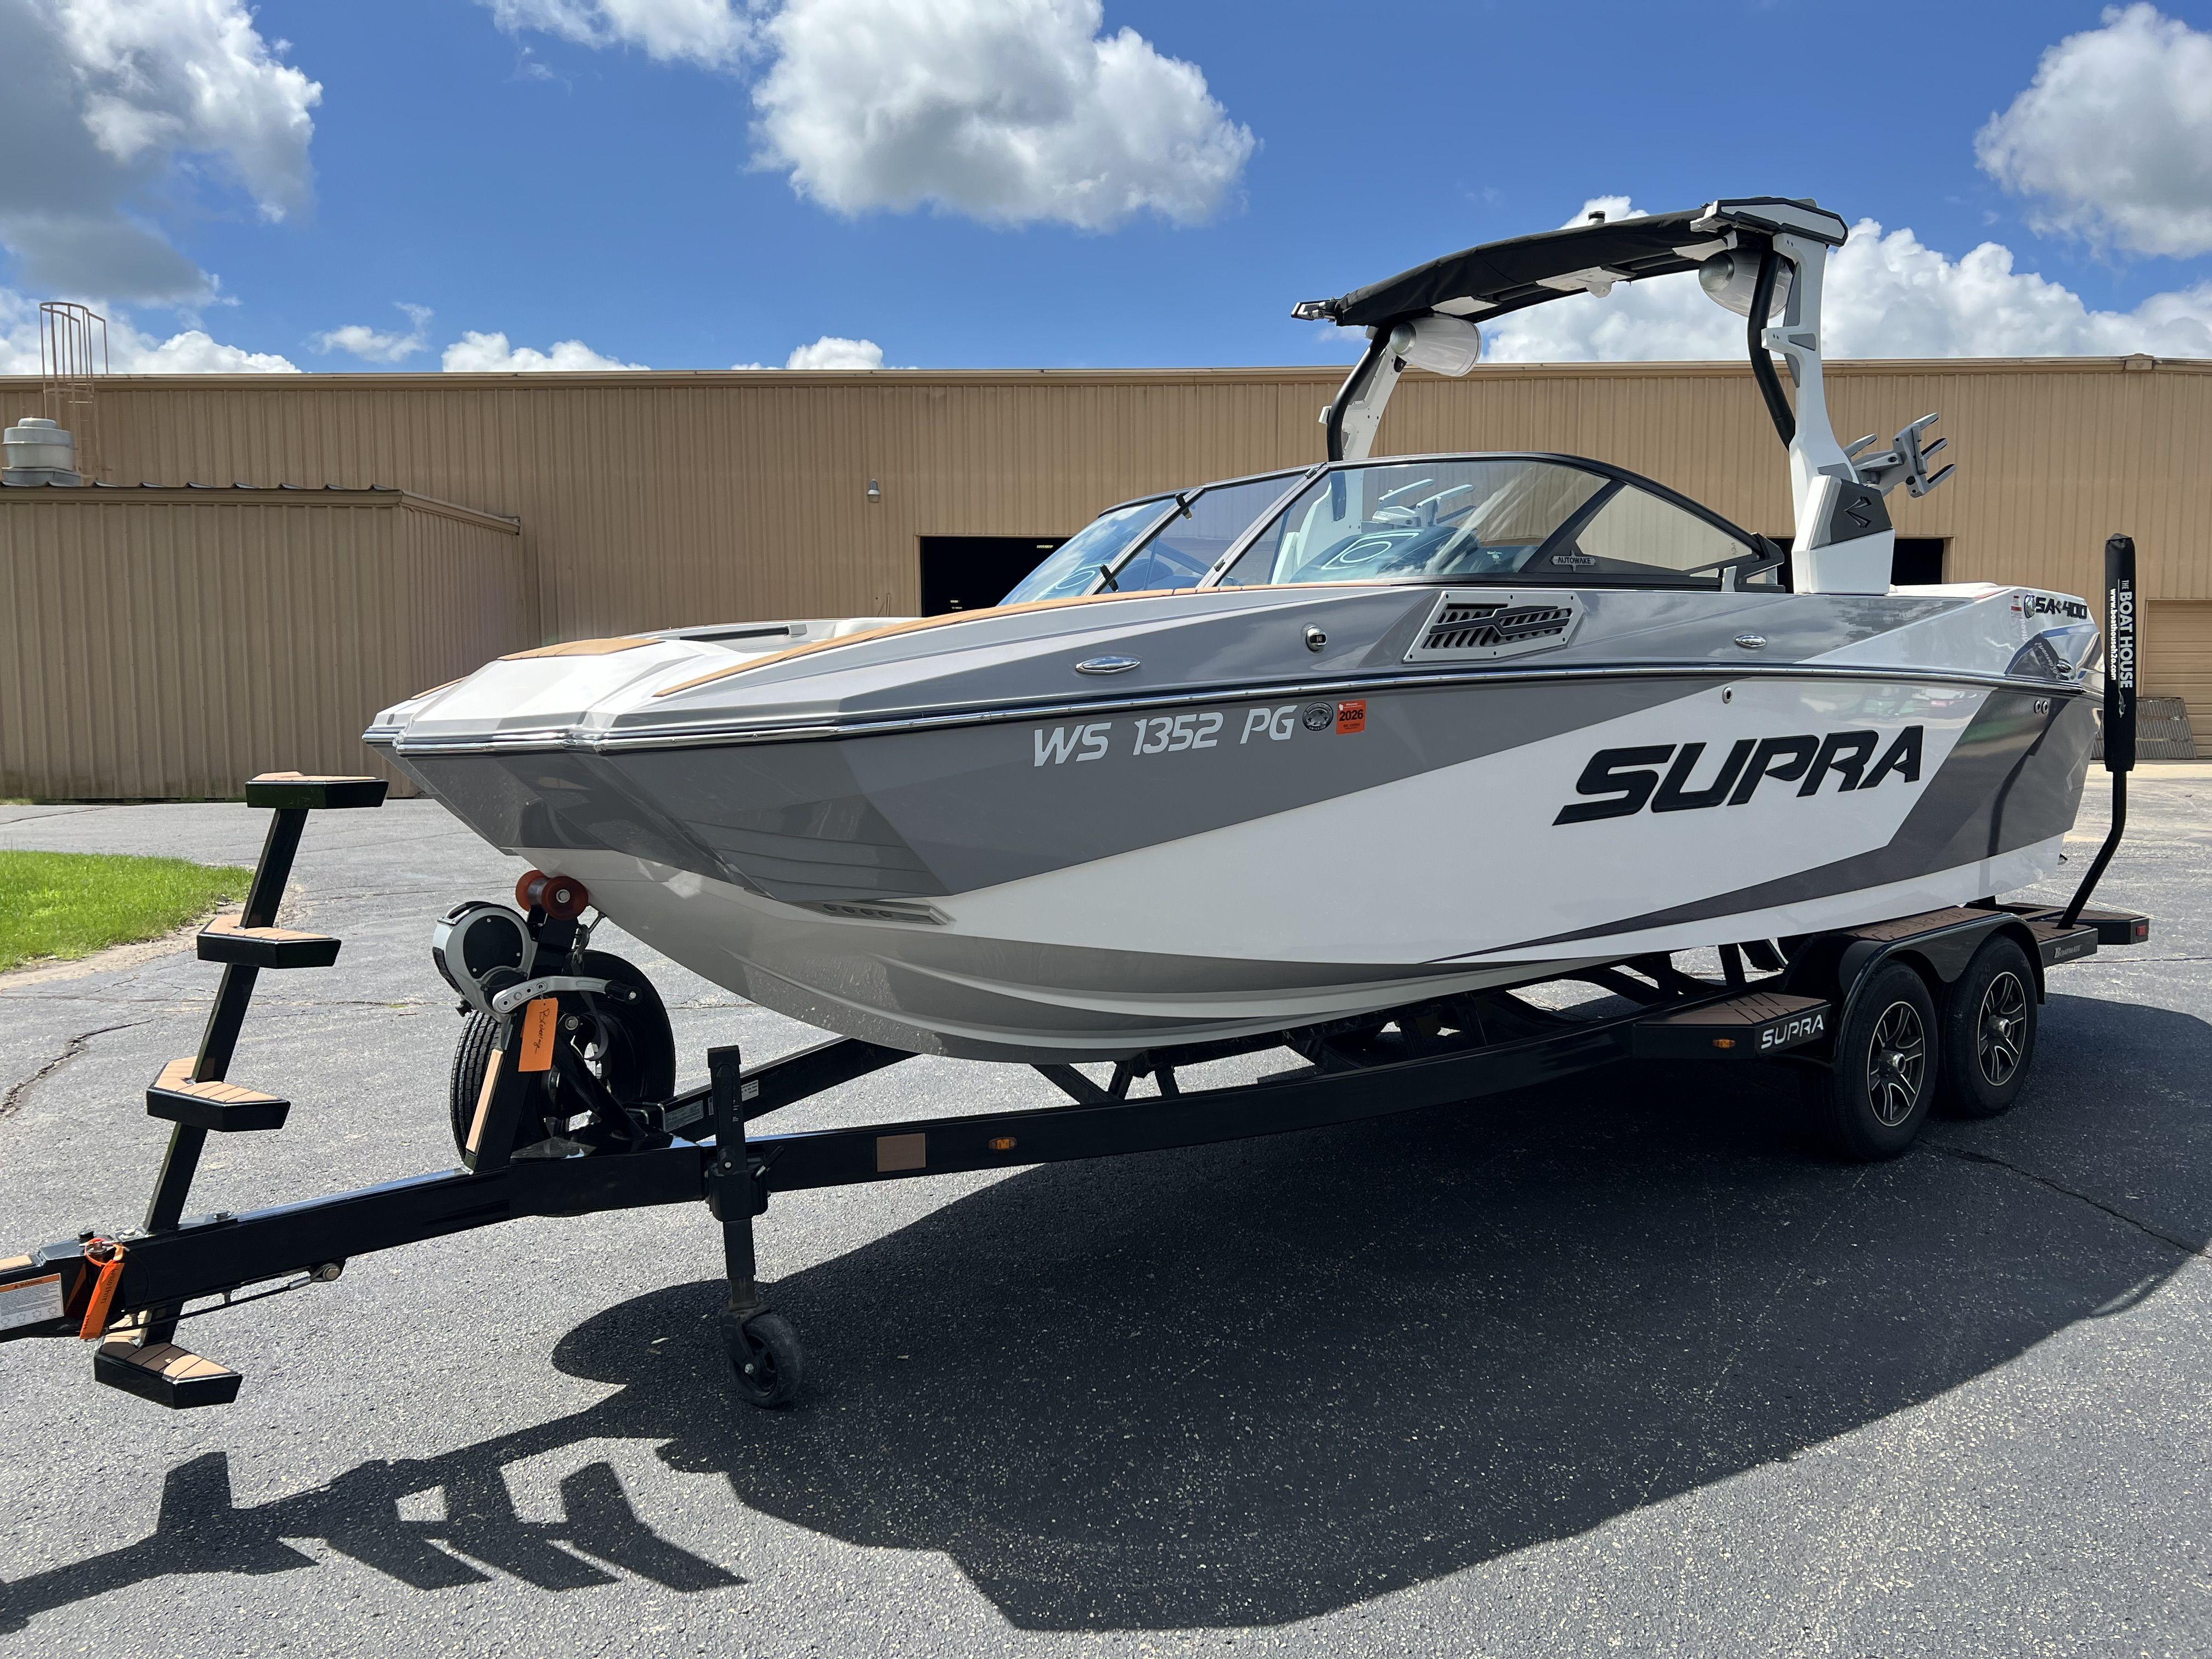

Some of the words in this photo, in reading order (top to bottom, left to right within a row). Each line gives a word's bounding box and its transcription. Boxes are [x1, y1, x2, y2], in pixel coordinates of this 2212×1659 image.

[2121, 580, 2129, 590] THE
[2119, 591, 2133, 632] BOAT
[2119, 636, 2133, 689] HOUSE
[1339, 709, 1364, 721] 2026
[1034, 722, 1111, 768] WS
[1133, 712, 1223, 756] 1352
[1240, 705, 1298, 744] PG
[1551, 725, 1924, 826] SUPRA
[1760, 1014, 1824, 1050] SUPRA
